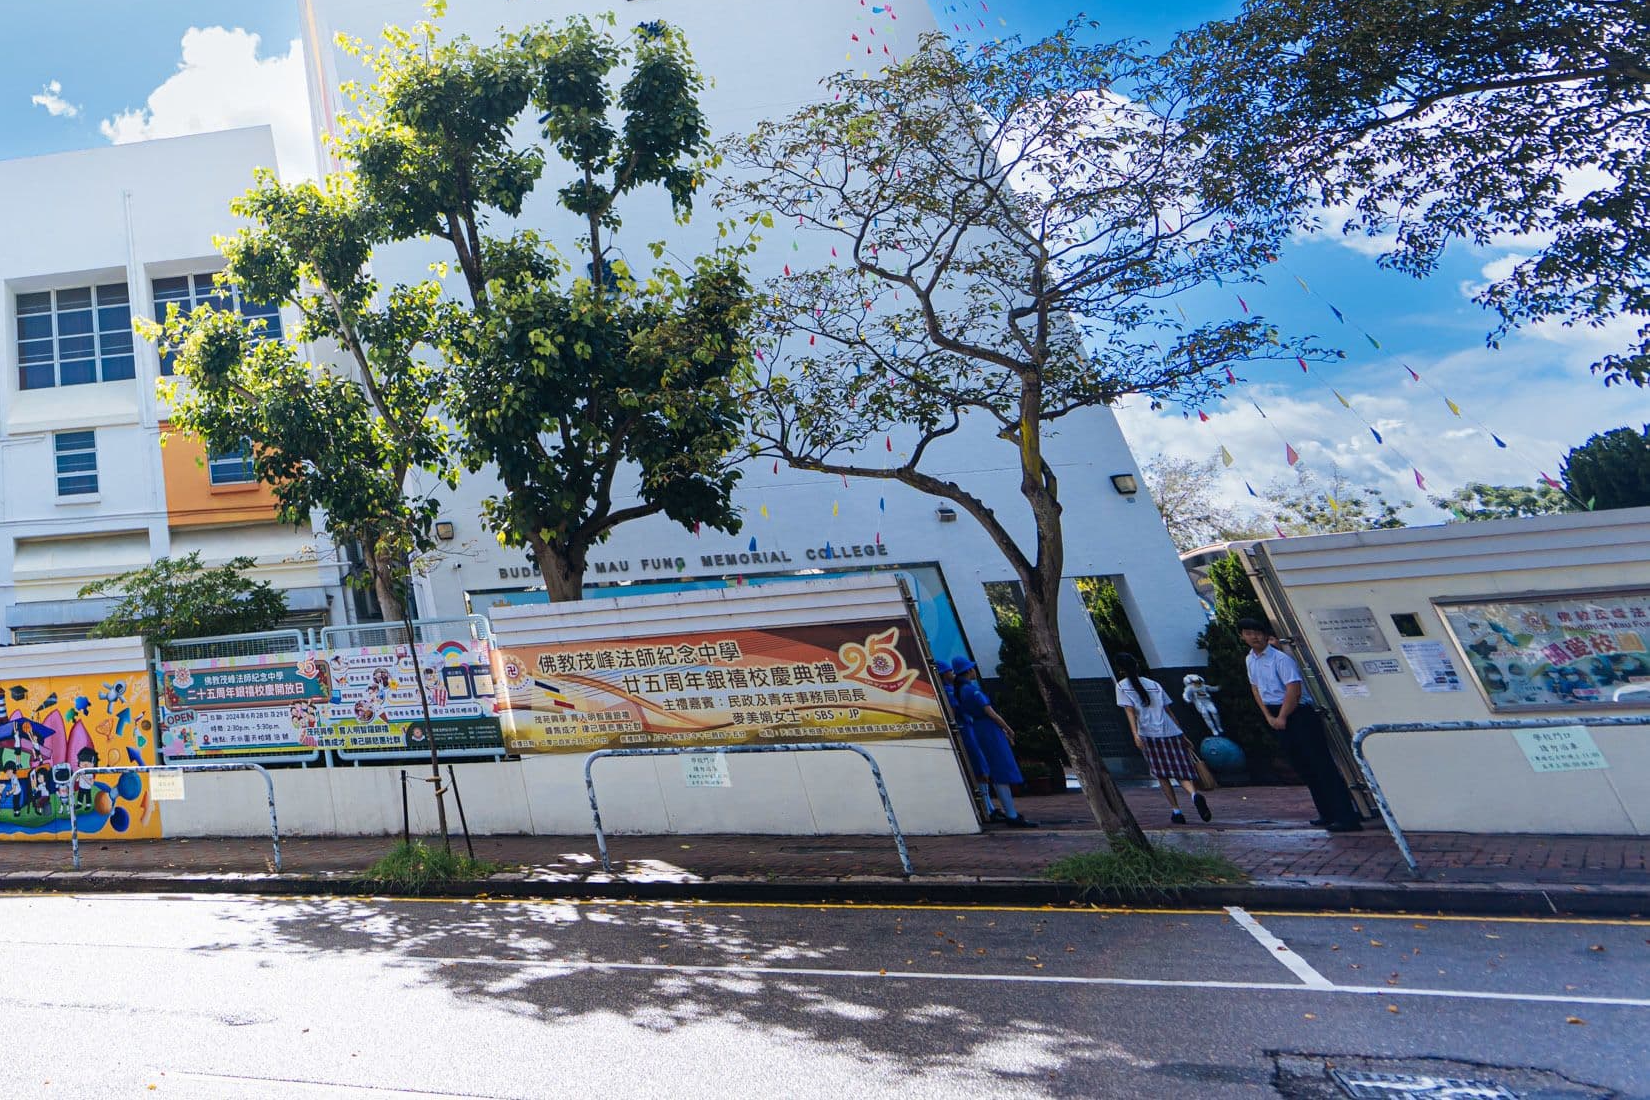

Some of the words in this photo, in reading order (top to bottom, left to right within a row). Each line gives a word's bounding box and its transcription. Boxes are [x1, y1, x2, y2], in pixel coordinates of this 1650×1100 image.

[594, 560, 630, 574] MAU
[700, 550, 792, 568] MEMORIAL
[805, 544, 889, 561] COLLEGE
[537, 640, 742, 675] 佛教茂峰法師紀念中學
[187, 682, 305, 701] 二十五周年銀禧校慶開放日
[204, 671, 284, 685] 佛教茂峰法師紀念中學
[621, 661, 840, 697] 廿五周年銀禧校慶典禮
[662, 686, 867, 713] 主禮嘉賓：民政及青年事務局局長
[167, 711, 195, 725] OPEN
